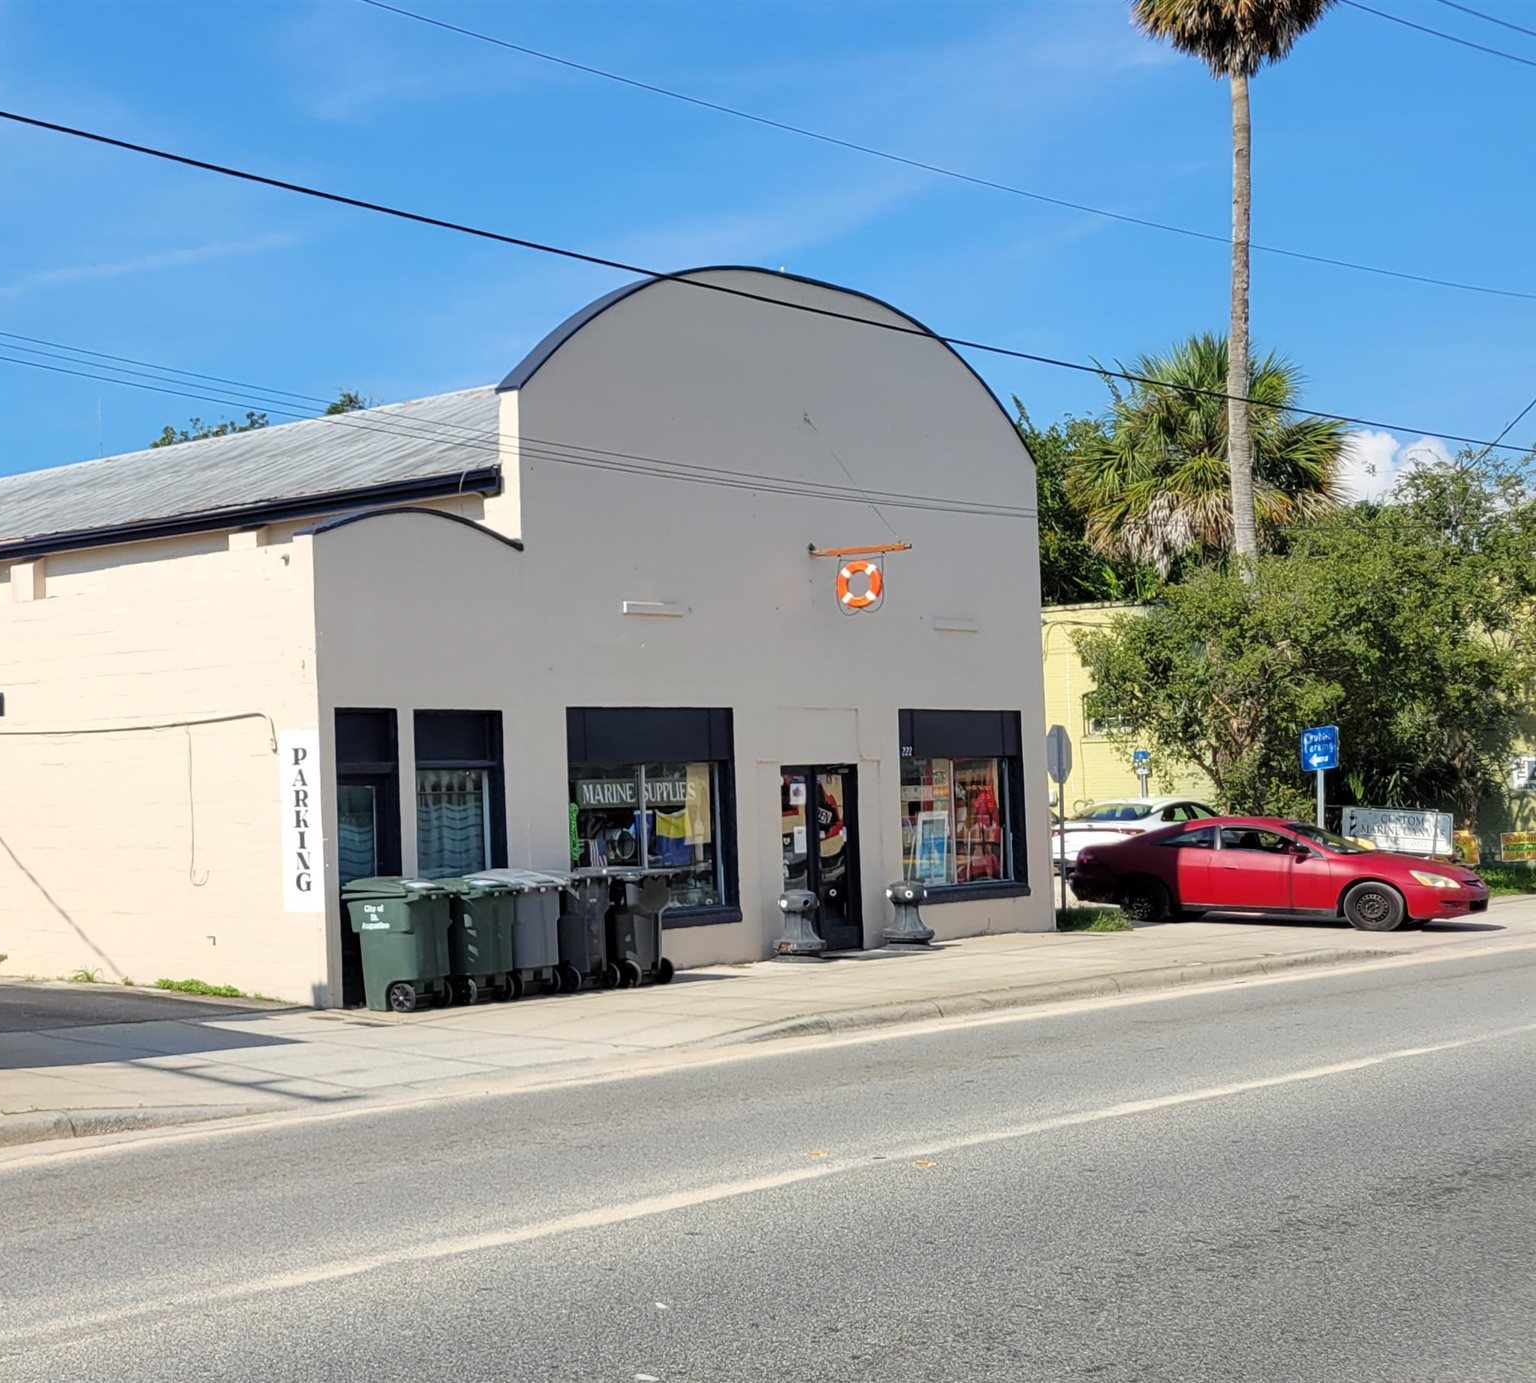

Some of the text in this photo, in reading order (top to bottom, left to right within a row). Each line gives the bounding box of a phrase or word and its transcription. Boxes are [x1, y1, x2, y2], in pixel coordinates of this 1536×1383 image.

[901, 746, 913, 756] 222
[582, 782, 696, 804] MARINE SUPPLIES
[291, 747, 312, 892] PARKING
[1381, 814, 1424, 827] CUSTOM
[1360, 824, 1445, 838] MARINE CANVAS
[364, 904, 376, 913] City
